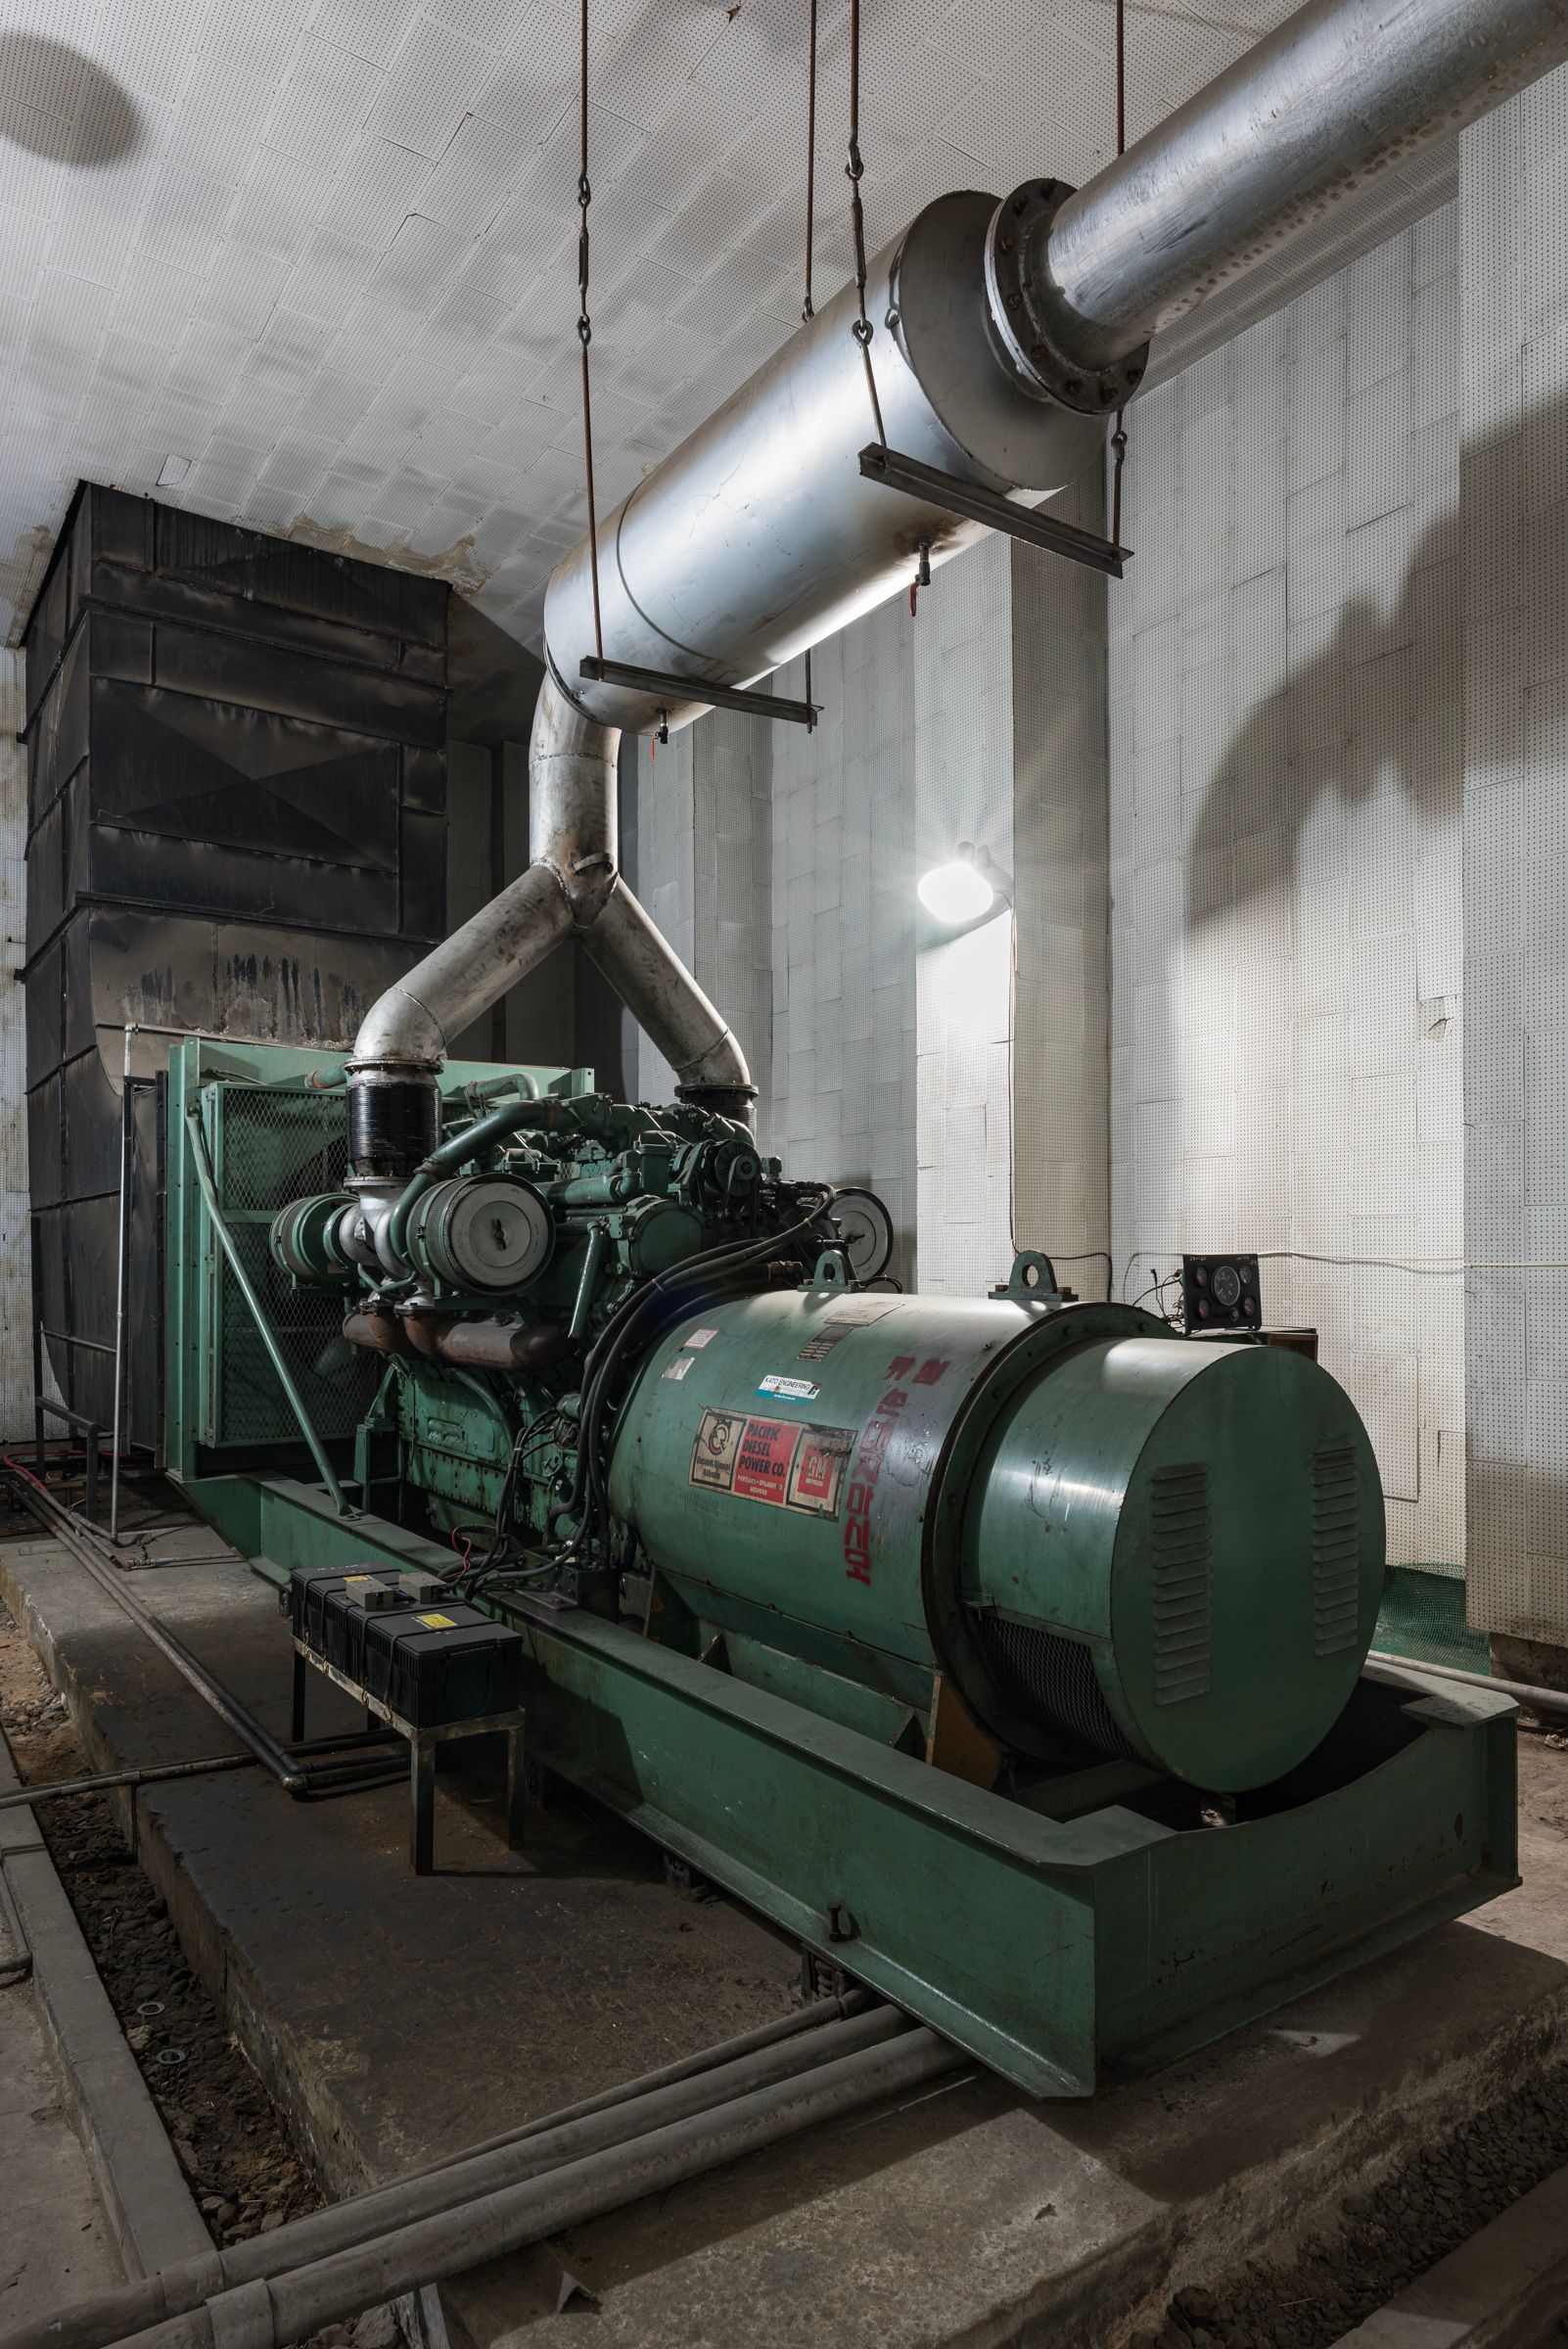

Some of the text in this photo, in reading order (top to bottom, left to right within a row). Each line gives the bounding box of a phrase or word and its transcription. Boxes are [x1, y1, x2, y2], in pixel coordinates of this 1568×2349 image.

[764, 1376, 810, 1391] KATO ENGINEERING
[747, 1423, 781, 1441] PACIFIC
[743, 1440, 771, 1457] DIESEL
[739, 1455, 786, 1478] POWER CO.
